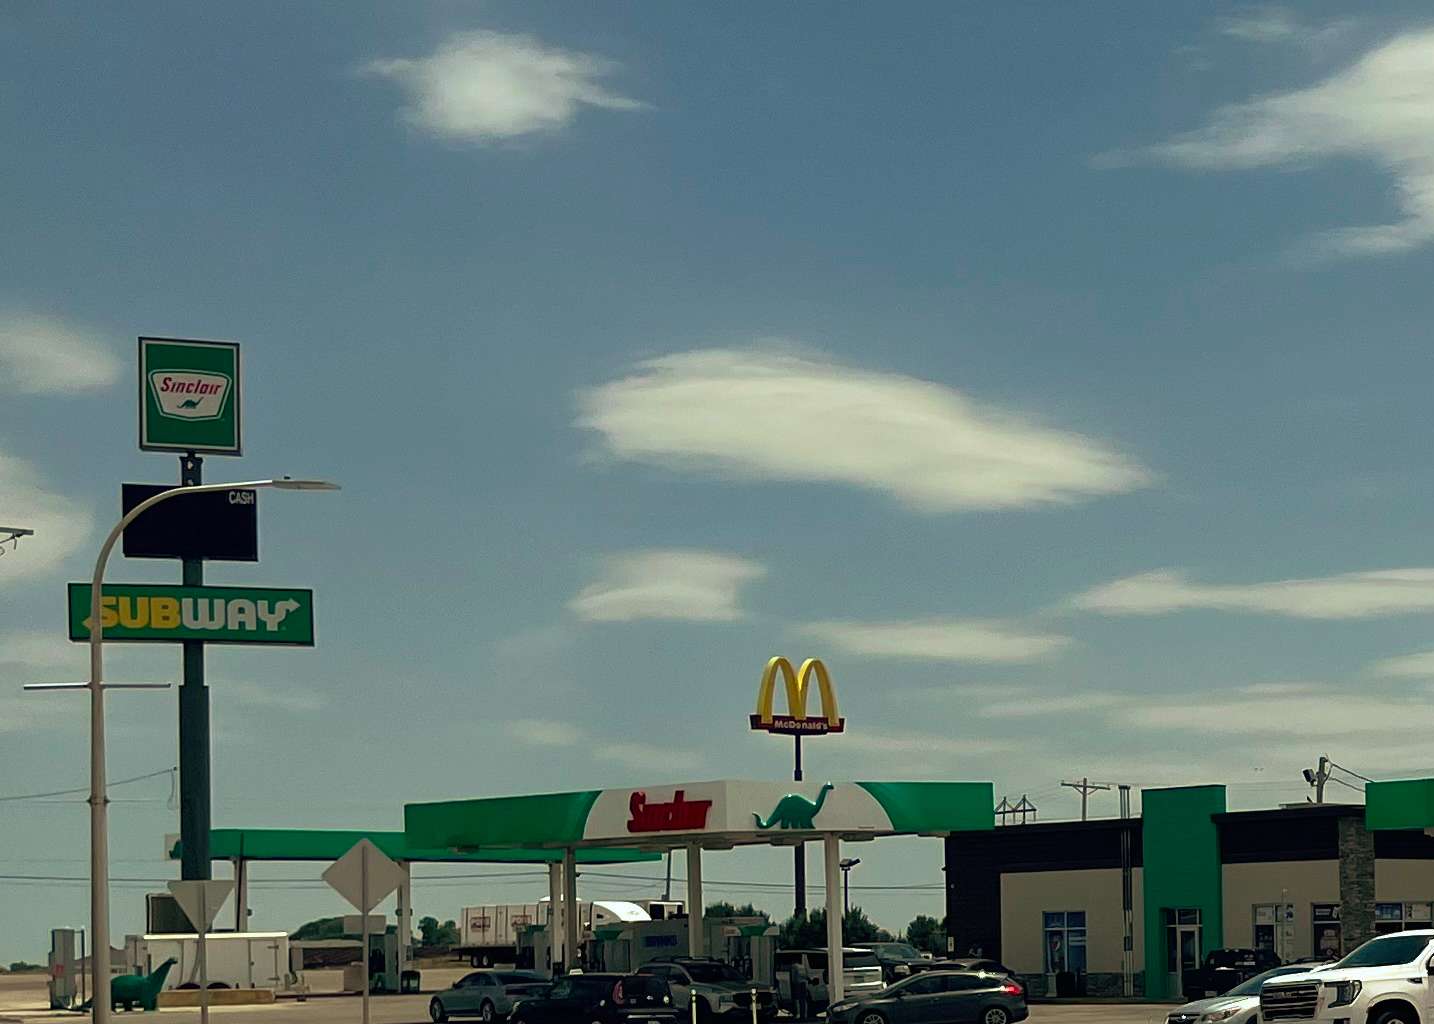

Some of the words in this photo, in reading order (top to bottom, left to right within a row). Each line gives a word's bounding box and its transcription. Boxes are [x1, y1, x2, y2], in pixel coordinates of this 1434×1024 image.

[161, 377, 222, 395] Sinclair
[229, 491, 254, 505] CASH
[82, 596, 301, 631] SUBWAY
[774, 720, 828, 730] McDonald's
